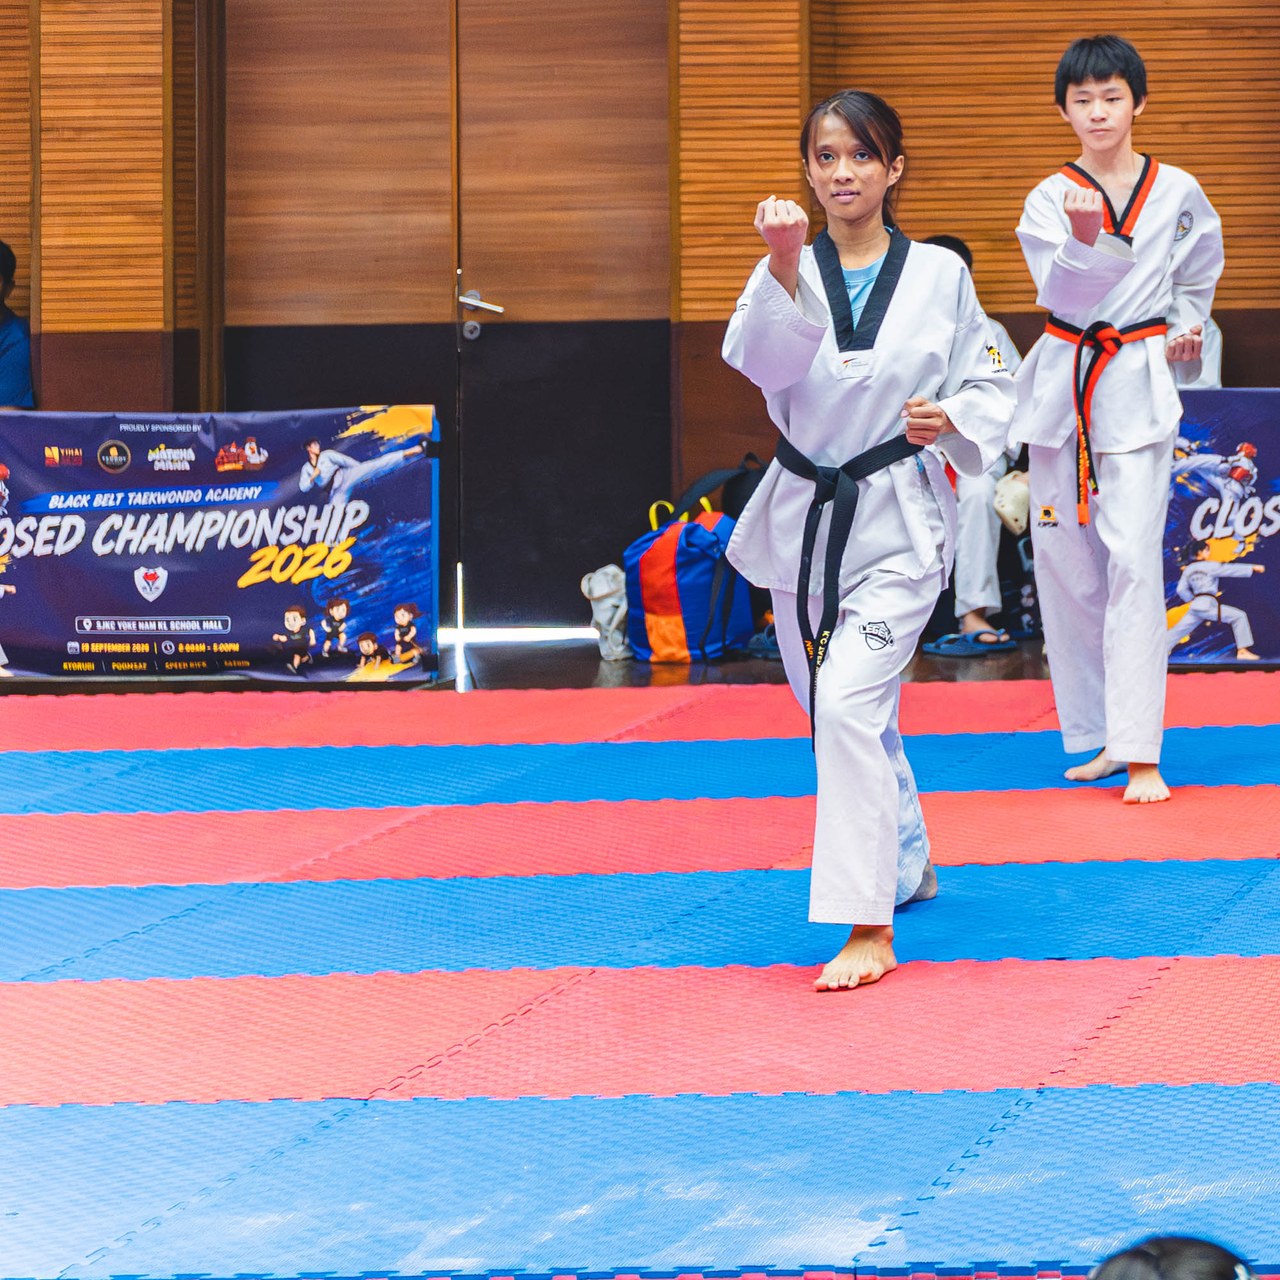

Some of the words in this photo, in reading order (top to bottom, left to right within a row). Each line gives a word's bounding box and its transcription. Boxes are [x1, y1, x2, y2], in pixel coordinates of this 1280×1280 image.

[119, 423, 150, 432] PROUDLY
[151, 423, 192, 432] SPONSORED
[193, 423, 202, 432] BY
[48, 494, 91, 509] BLACK
[92, 491, 123, 508] BELT
[127, 489, 202, 506] TAEKWONDO
[204, 486, 263, 502] ACADEMY
[91, 500, 371, 556] CHAMPIONSHIP
[237, 536, 357, 589] 2026
[117, 621, 137, 631] YOKE
[169, 620, 201, 630] SCHOOL
[202, 620, 223, 630] HALL
[91, 642, 131, 653] SEPTEMBER
